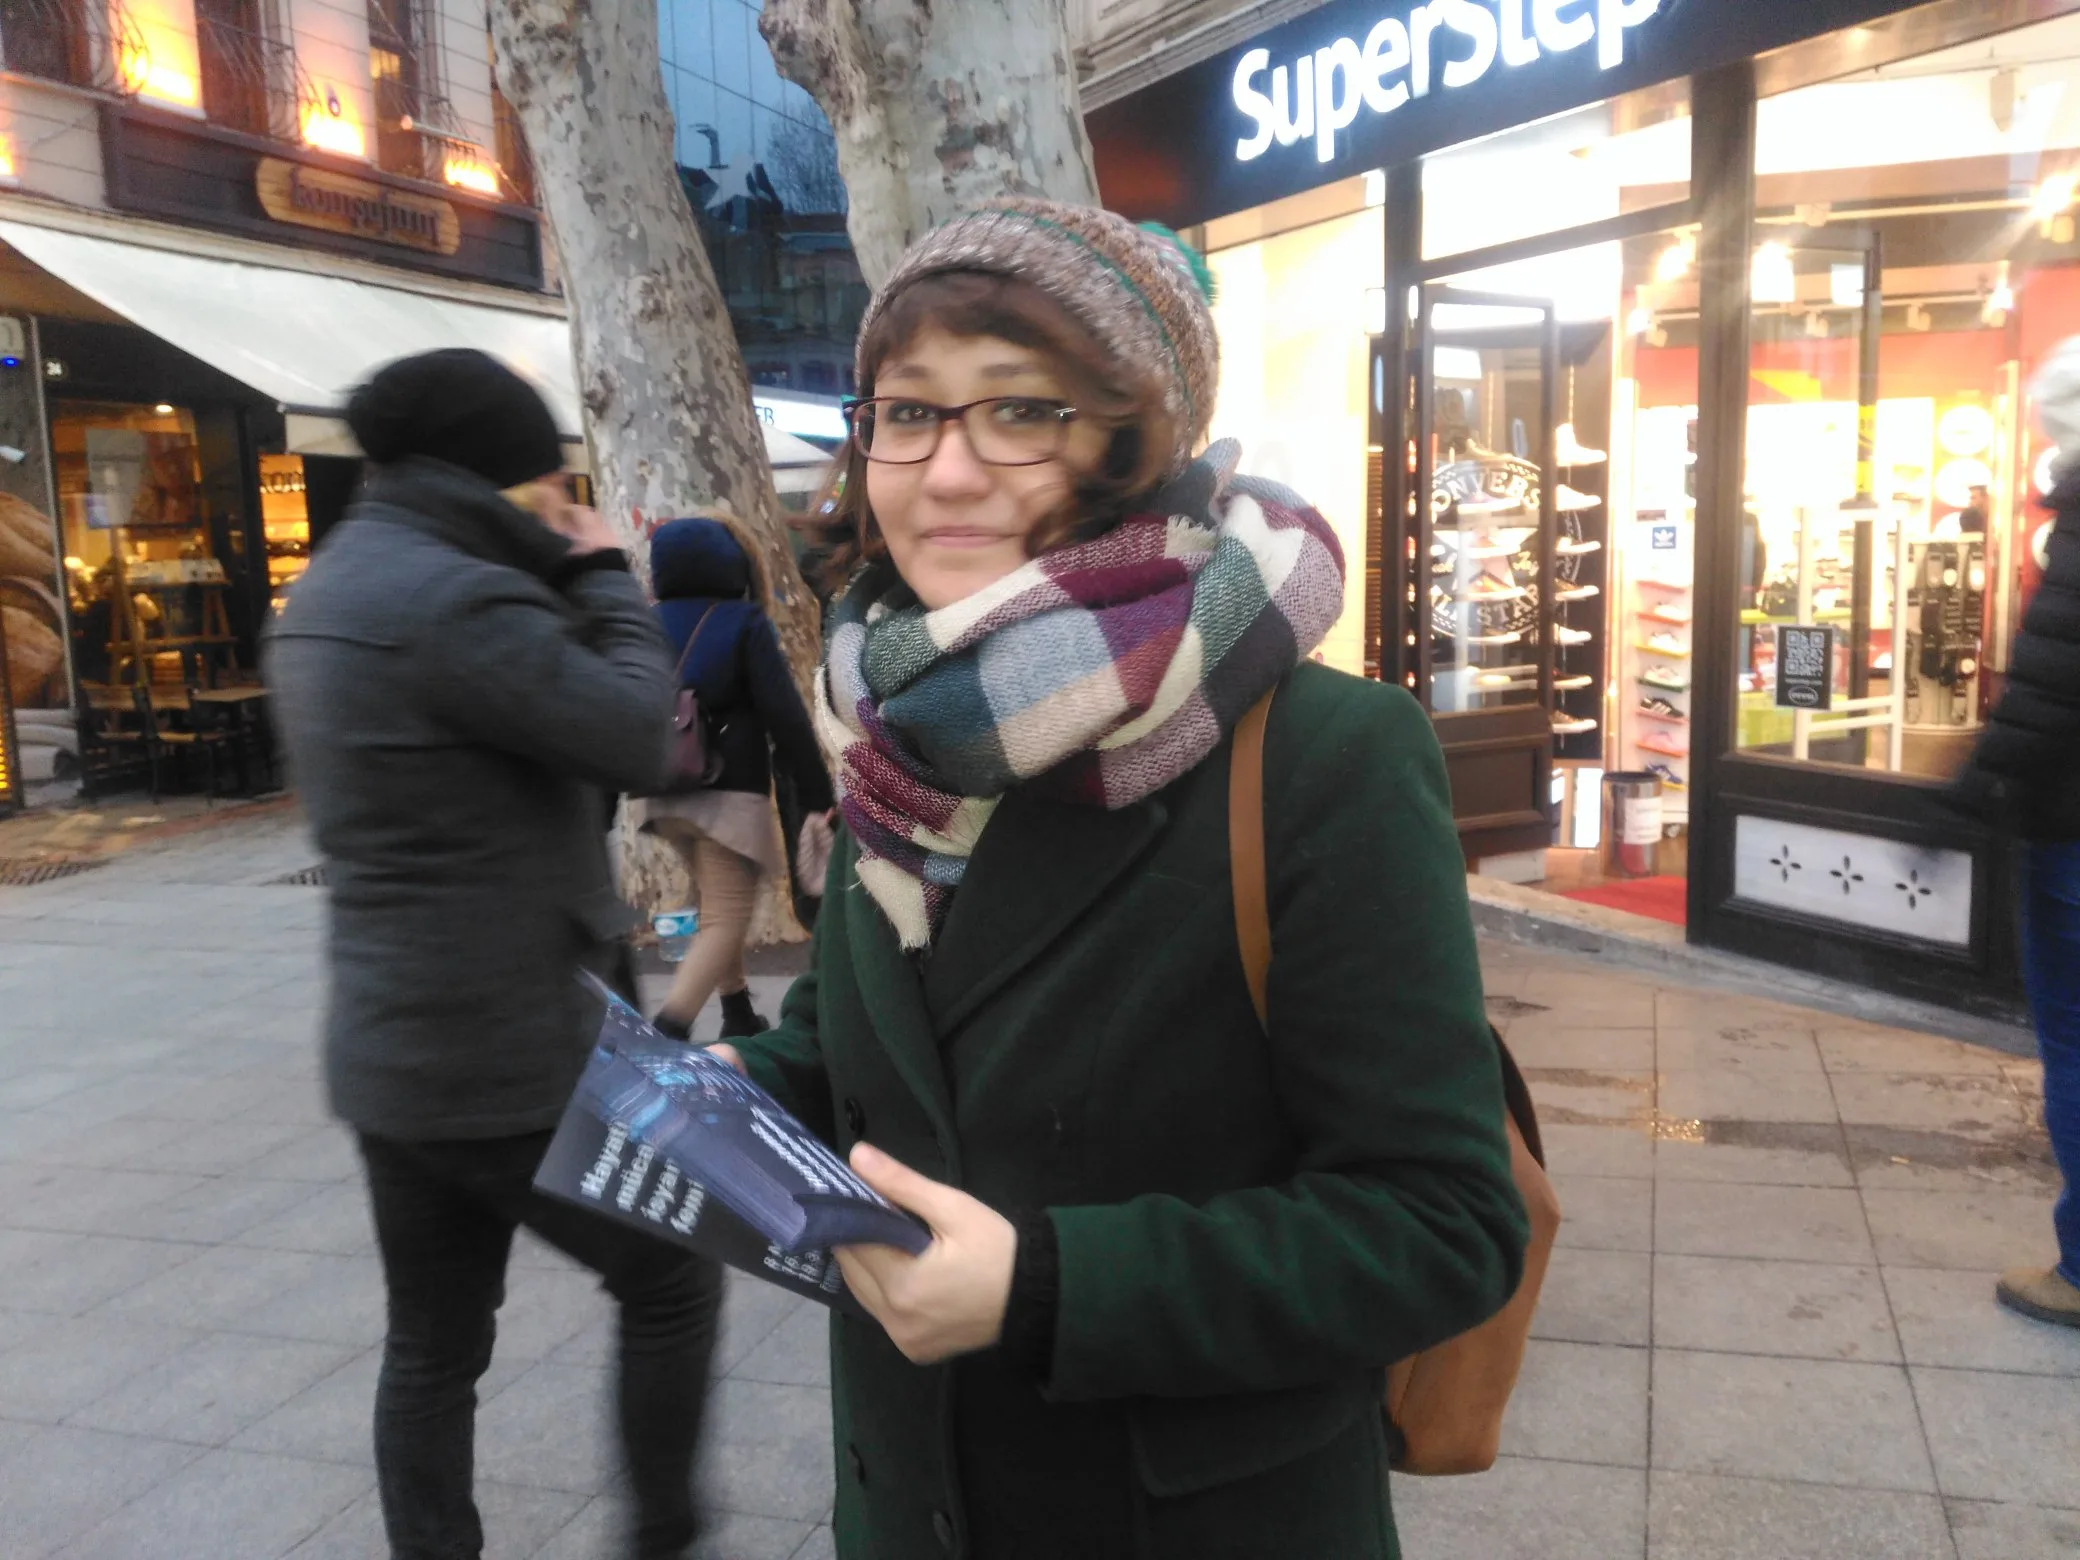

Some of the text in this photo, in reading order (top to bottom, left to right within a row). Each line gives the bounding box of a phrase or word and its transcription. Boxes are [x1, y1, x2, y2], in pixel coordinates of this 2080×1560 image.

[1232, 0, 1660, 163] SuperStep
[1432, 471, 1541, 512] ONVERS
[616, 1144, 655, 1212] müca
